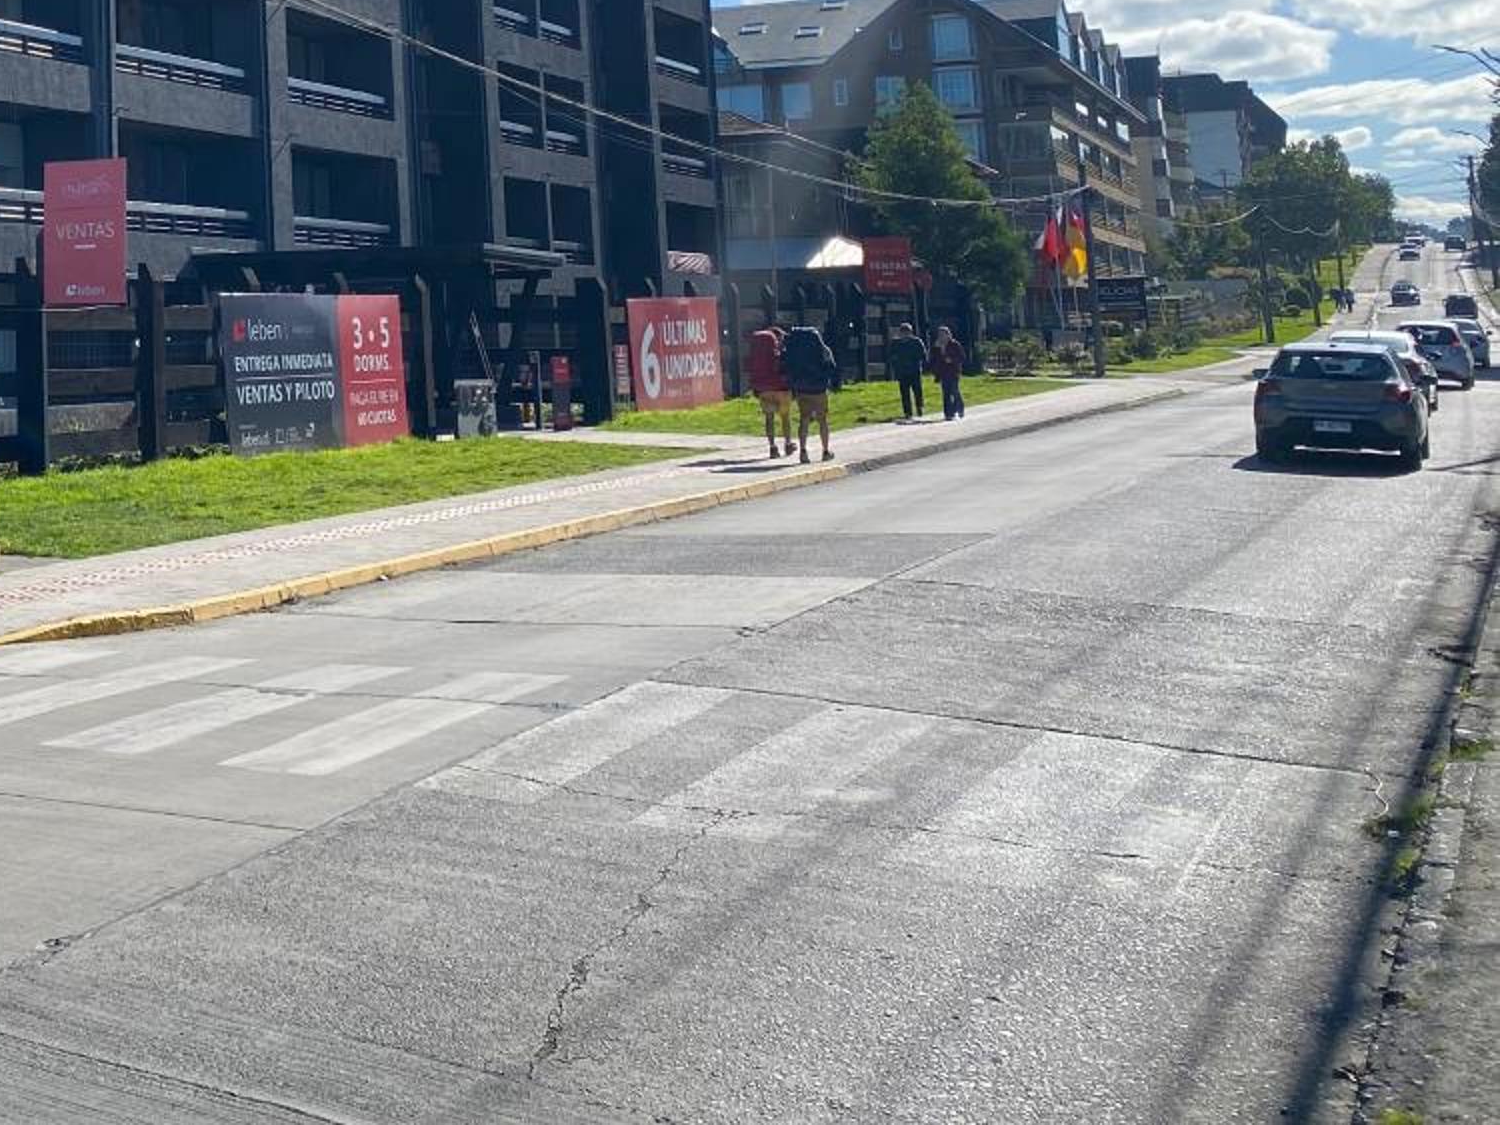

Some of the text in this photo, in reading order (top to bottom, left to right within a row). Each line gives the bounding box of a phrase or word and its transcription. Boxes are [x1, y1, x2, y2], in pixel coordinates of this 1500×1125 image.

[55, 222, 115, 240] VENTAS
[247, 318, 282, 340] leben
[352, 316, 389, 349] 3 5
[663, 314, 707, 346] ÚLTIMAS
[234, 354, 280, 372] ENTREGA
[641, 322, 661, 399] 6
[664, 351, 716, 379] UNIDADES
[236, 380, 336, 405] VENTAS Y PILOTO
